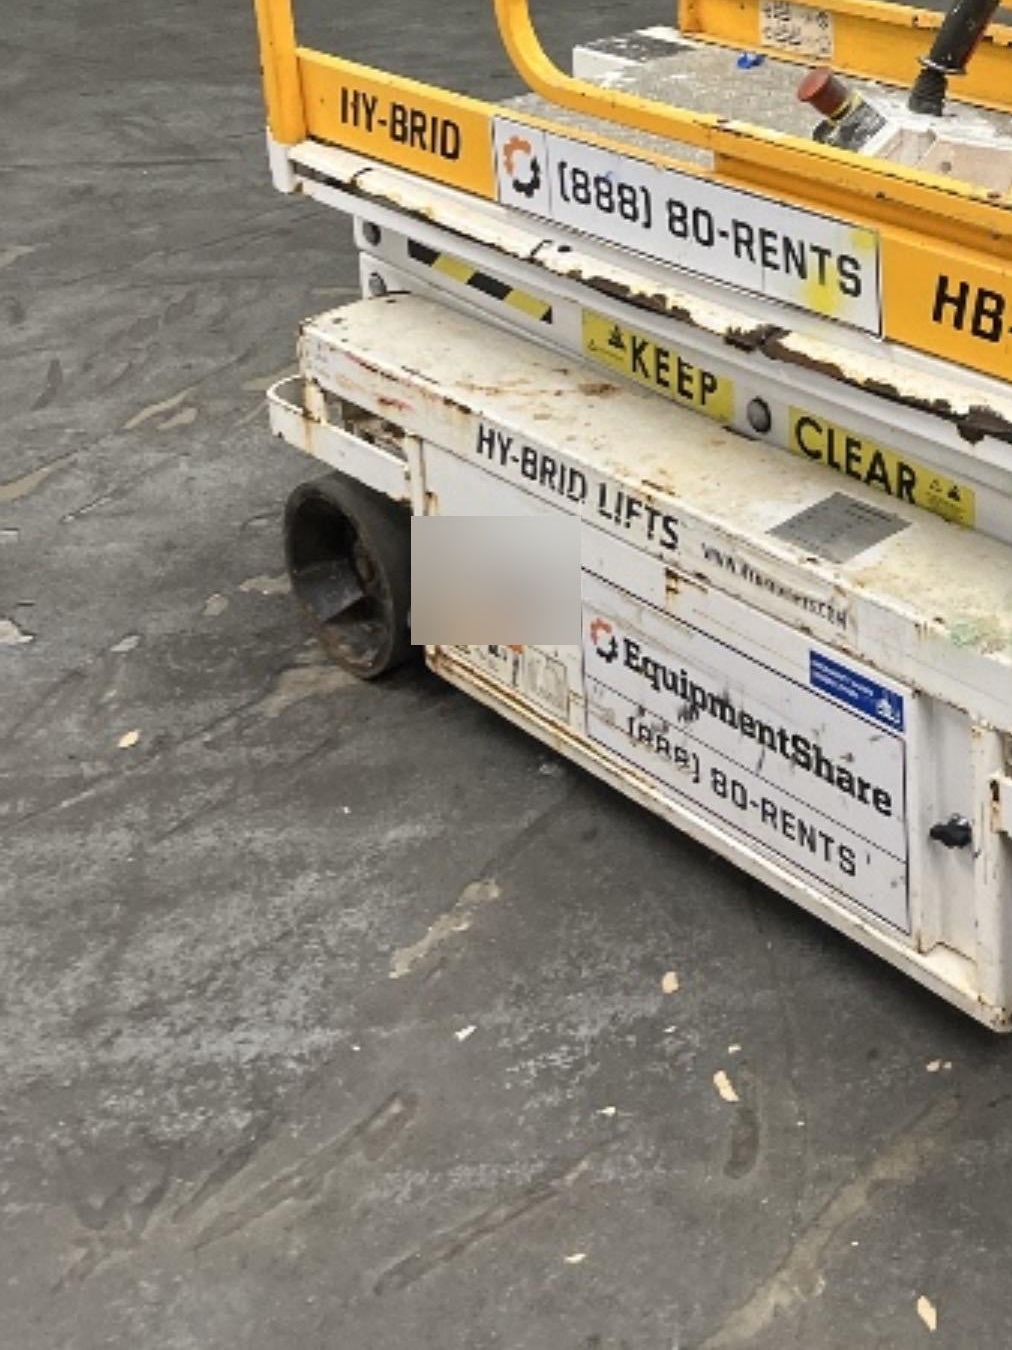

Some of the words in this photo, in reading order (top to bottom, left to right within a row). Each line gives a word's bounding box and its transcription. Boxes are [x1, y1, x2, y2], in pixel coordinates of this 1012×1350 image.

[340, 86, 462, 161] HY-BRID
[557, 160, 653, 229] (888)
[666, 197, 863, 299] 80-RENTS
[629, 332, 719, 407] KEEP
[794, 415, 918, 506] CLEAR
[475, 423, 588, 505] HY-BRID
[598, 482, 680, 550] LIFTS
[622, 637, 894, 817] EquipmentShare
[710, 766, 858, 877] 80-RENTS
